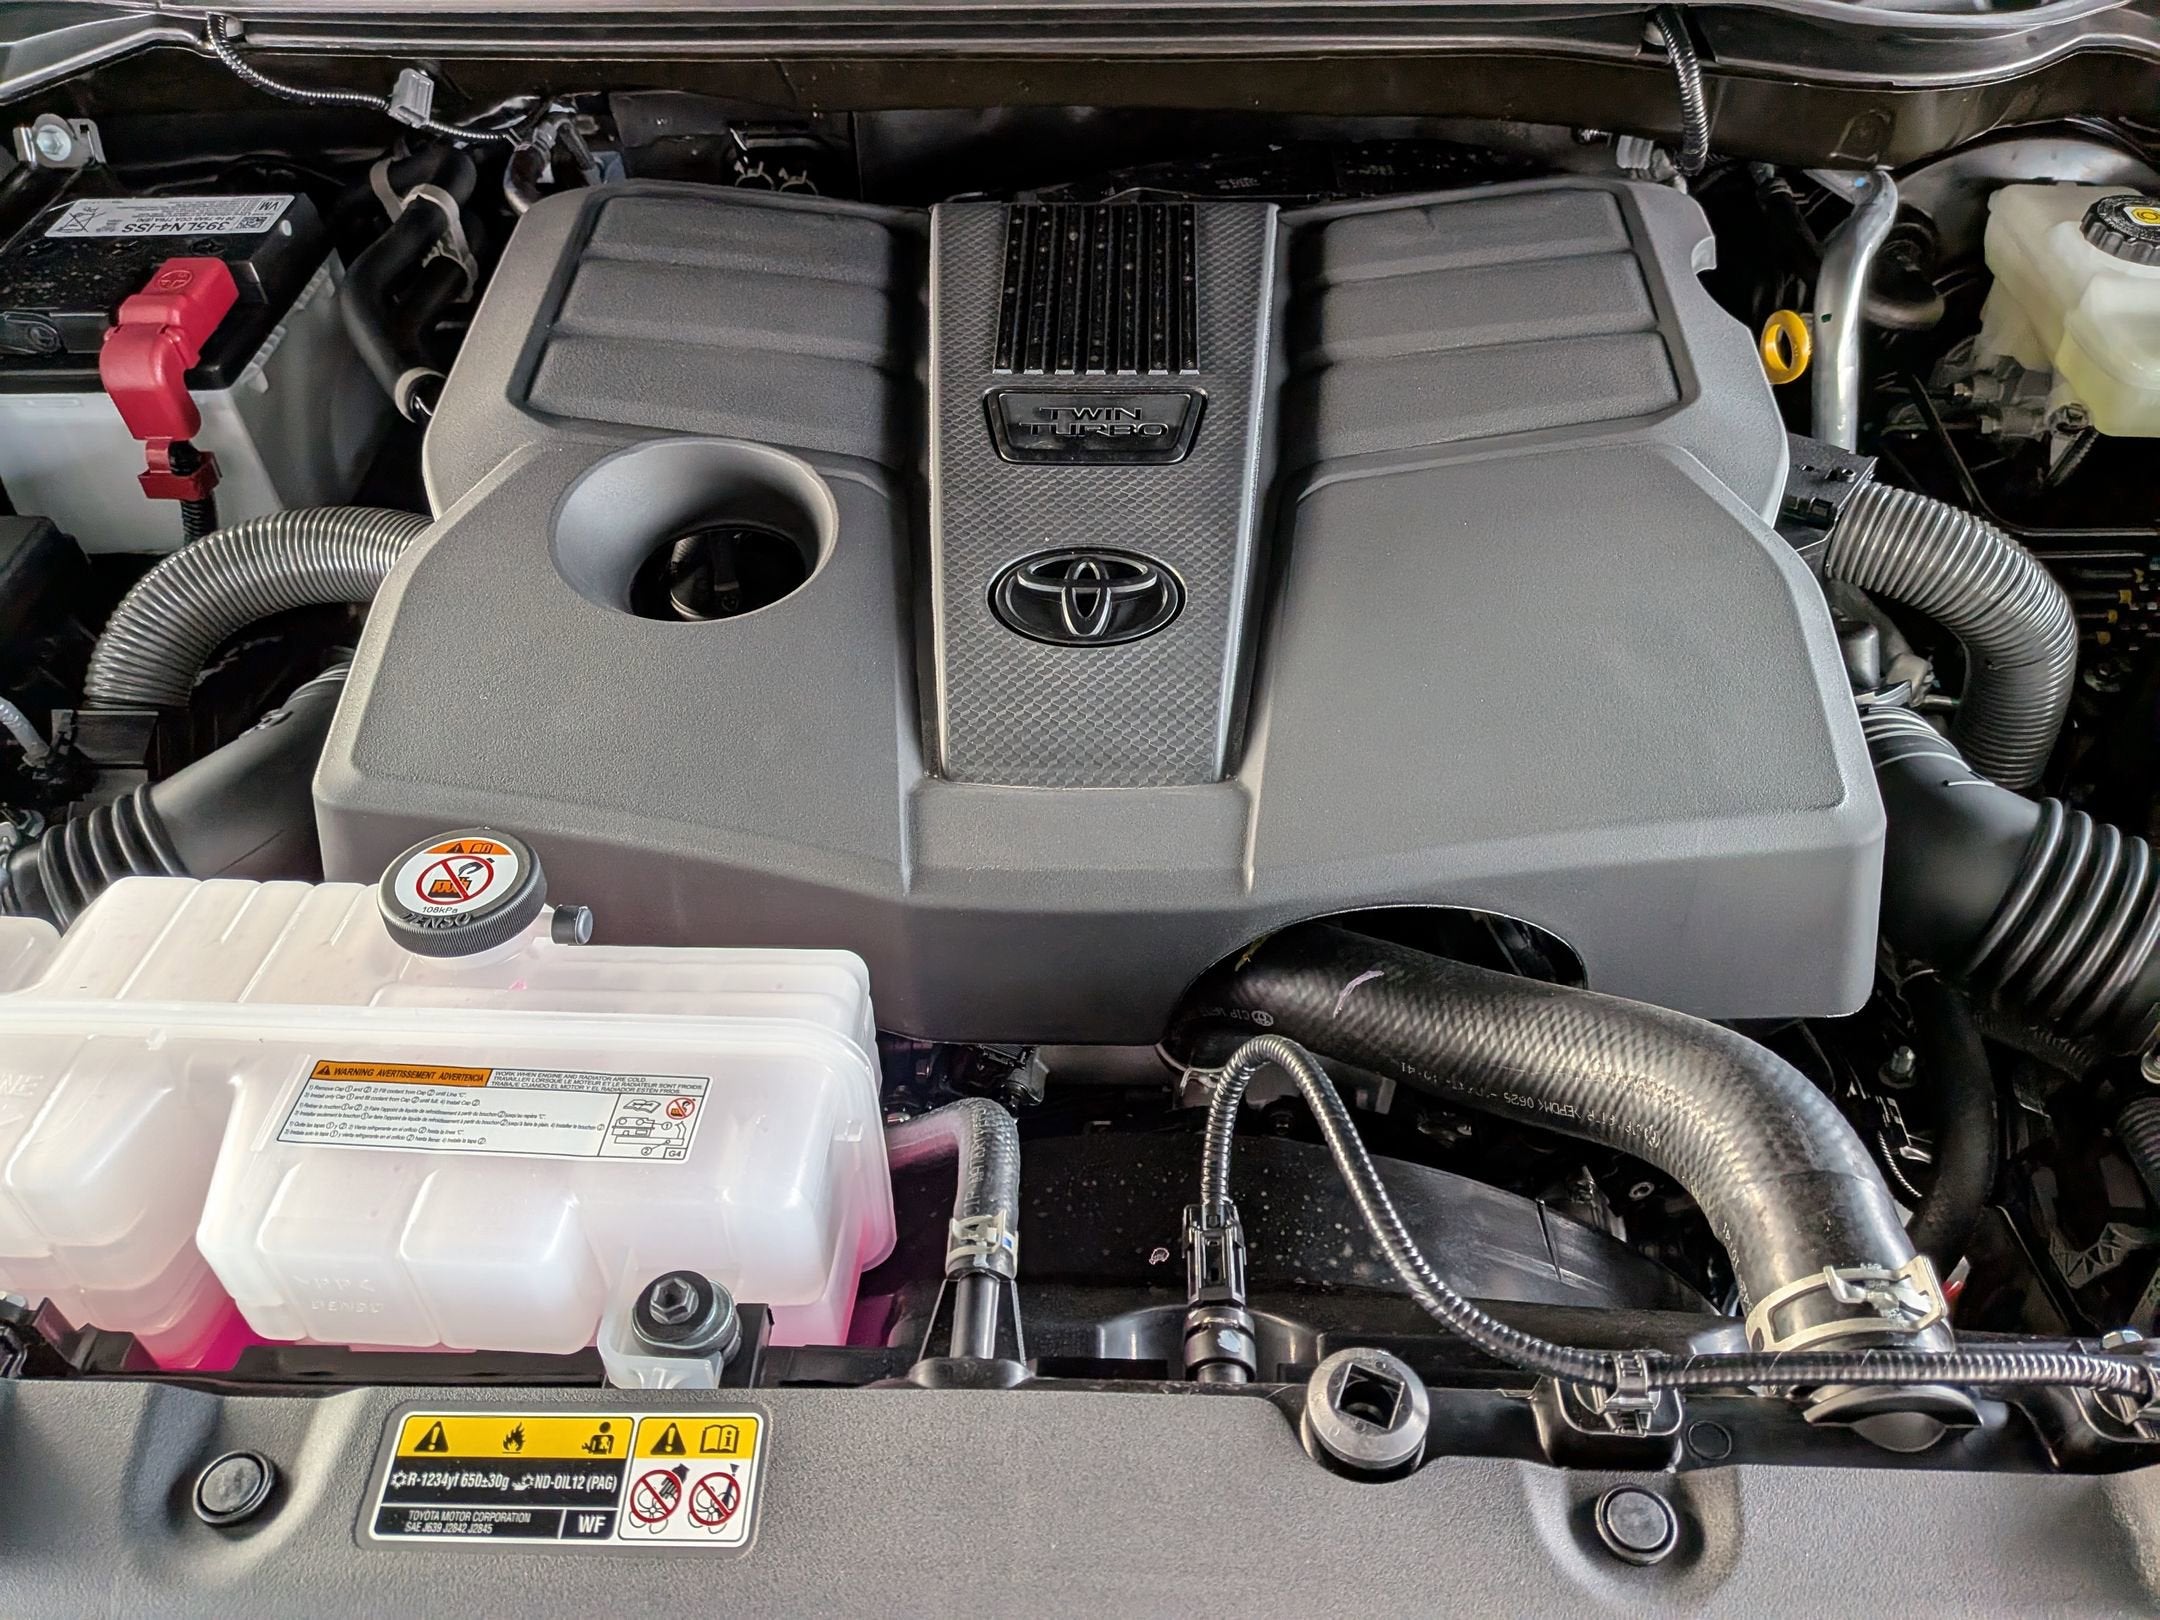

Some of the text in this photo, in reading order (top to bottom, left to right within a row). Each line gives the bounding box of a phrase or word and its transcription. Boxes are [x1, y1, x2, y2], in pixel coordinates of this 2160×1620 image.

[259, 202, 279, 210] VM
[122, 222, 230, 233] 395LN4-ISS
[1039, 407, 1142, 421] TWIN
[1019, 422, 1168, 437] TURBO
[399, 912, 472, 929] DENSO
[334, 1068, 484, 1082] WARNING AVERTISSEMENT ADVERTENCIA
[668, 1150, 682, 1158] G4
[407, 1472, 617, 1493] R-1234yf 650±30g ND-OIL12 (PAG)
[408, 1510, 531, 1523] TOYOTA MOTOR CORPORATION
[404, 1522, 493, 1534] SAE J639 J2842 J2845
[578, 1515, 606, 1533] WF
